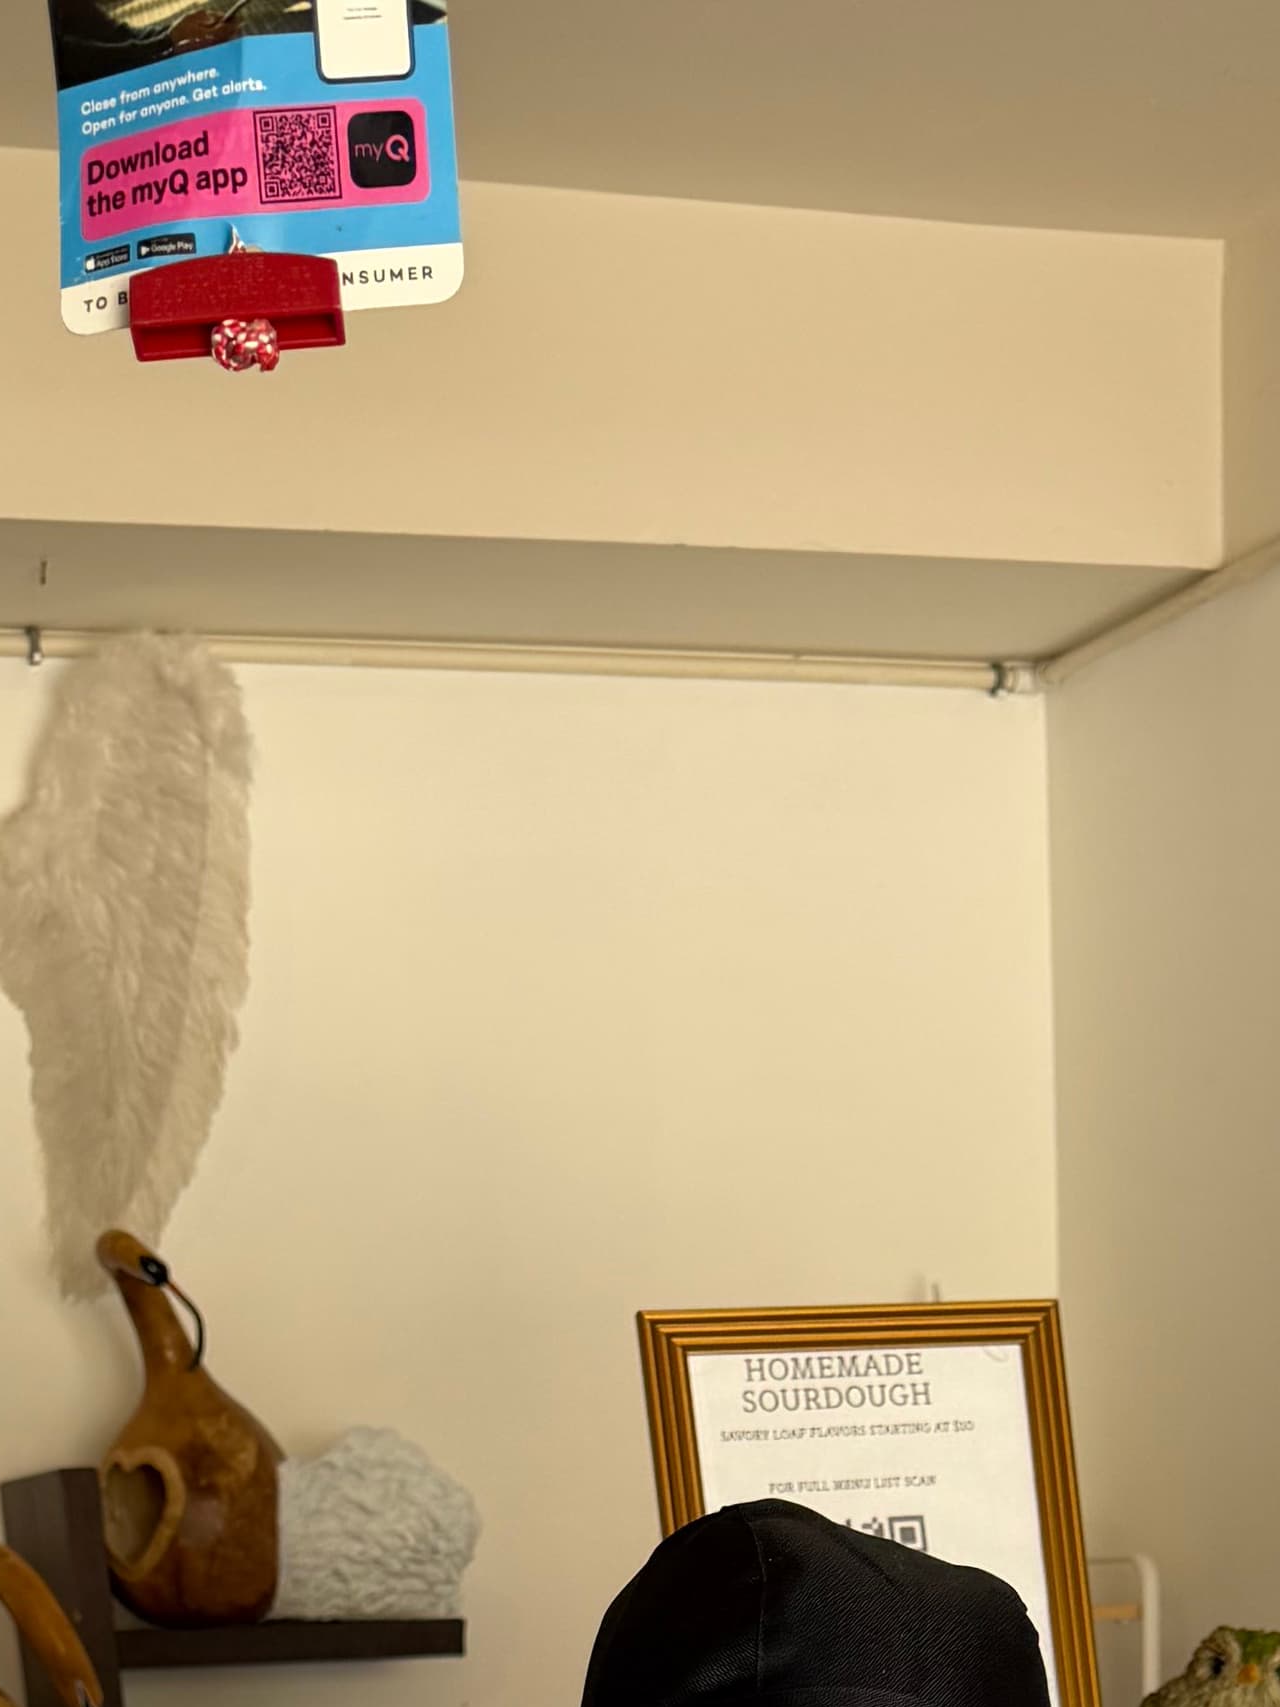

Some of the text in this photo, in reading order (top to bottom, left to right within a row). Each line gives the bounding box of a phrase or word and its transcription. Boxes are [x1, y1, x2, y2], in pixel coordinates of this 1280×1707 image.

[80, 67, 219, 116] Close from anywhere.
[81, 77, 267, 136] Open for anyone. Get alerts.
[87, 130, 210, 185] Download
[354, 134, 410, 162] myQ
[87, 167, 248, 218] the myQ app
[151, 240, 176, 252] Google
[177, 239, 193, 251] Play
[83, 266, 434, 313] TO B NSUMER
[744, 1352, 924, 1382] HOMEMADE
[742, 1382, 933, 1413] SOURDOUGH
[720, 1429, 770, 1442] SAVORY
[772, 1427, 807, 1441] LOAF
[809, 1424, 866, 1438] FLAVORS
[870, 1422, 931, 1436] STARTING
[933, 1420, 950, 1433] AT
[769, 1475, 937, 1495] FOR FULL MENU LIST SCAN
